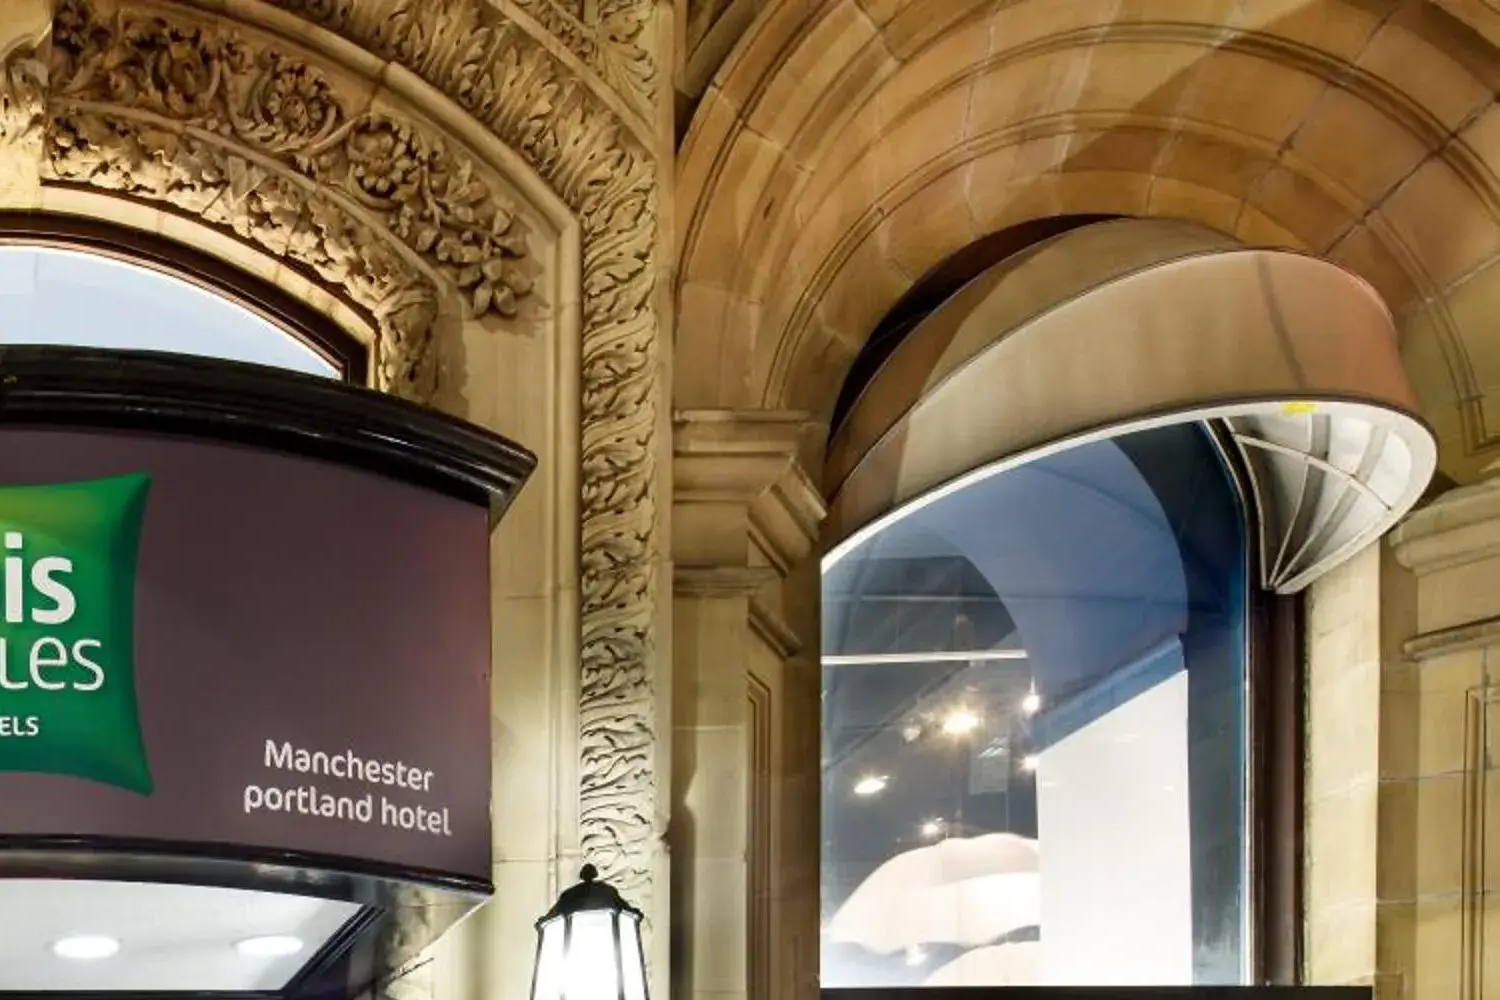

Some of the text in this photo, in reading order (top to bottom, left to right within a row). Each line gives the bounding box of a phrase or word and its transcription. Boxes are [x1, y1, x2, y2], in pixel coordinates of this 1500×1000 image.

[264, 739, 434, 792] Manchester
[244, 784, 452, 836] portland hotel
